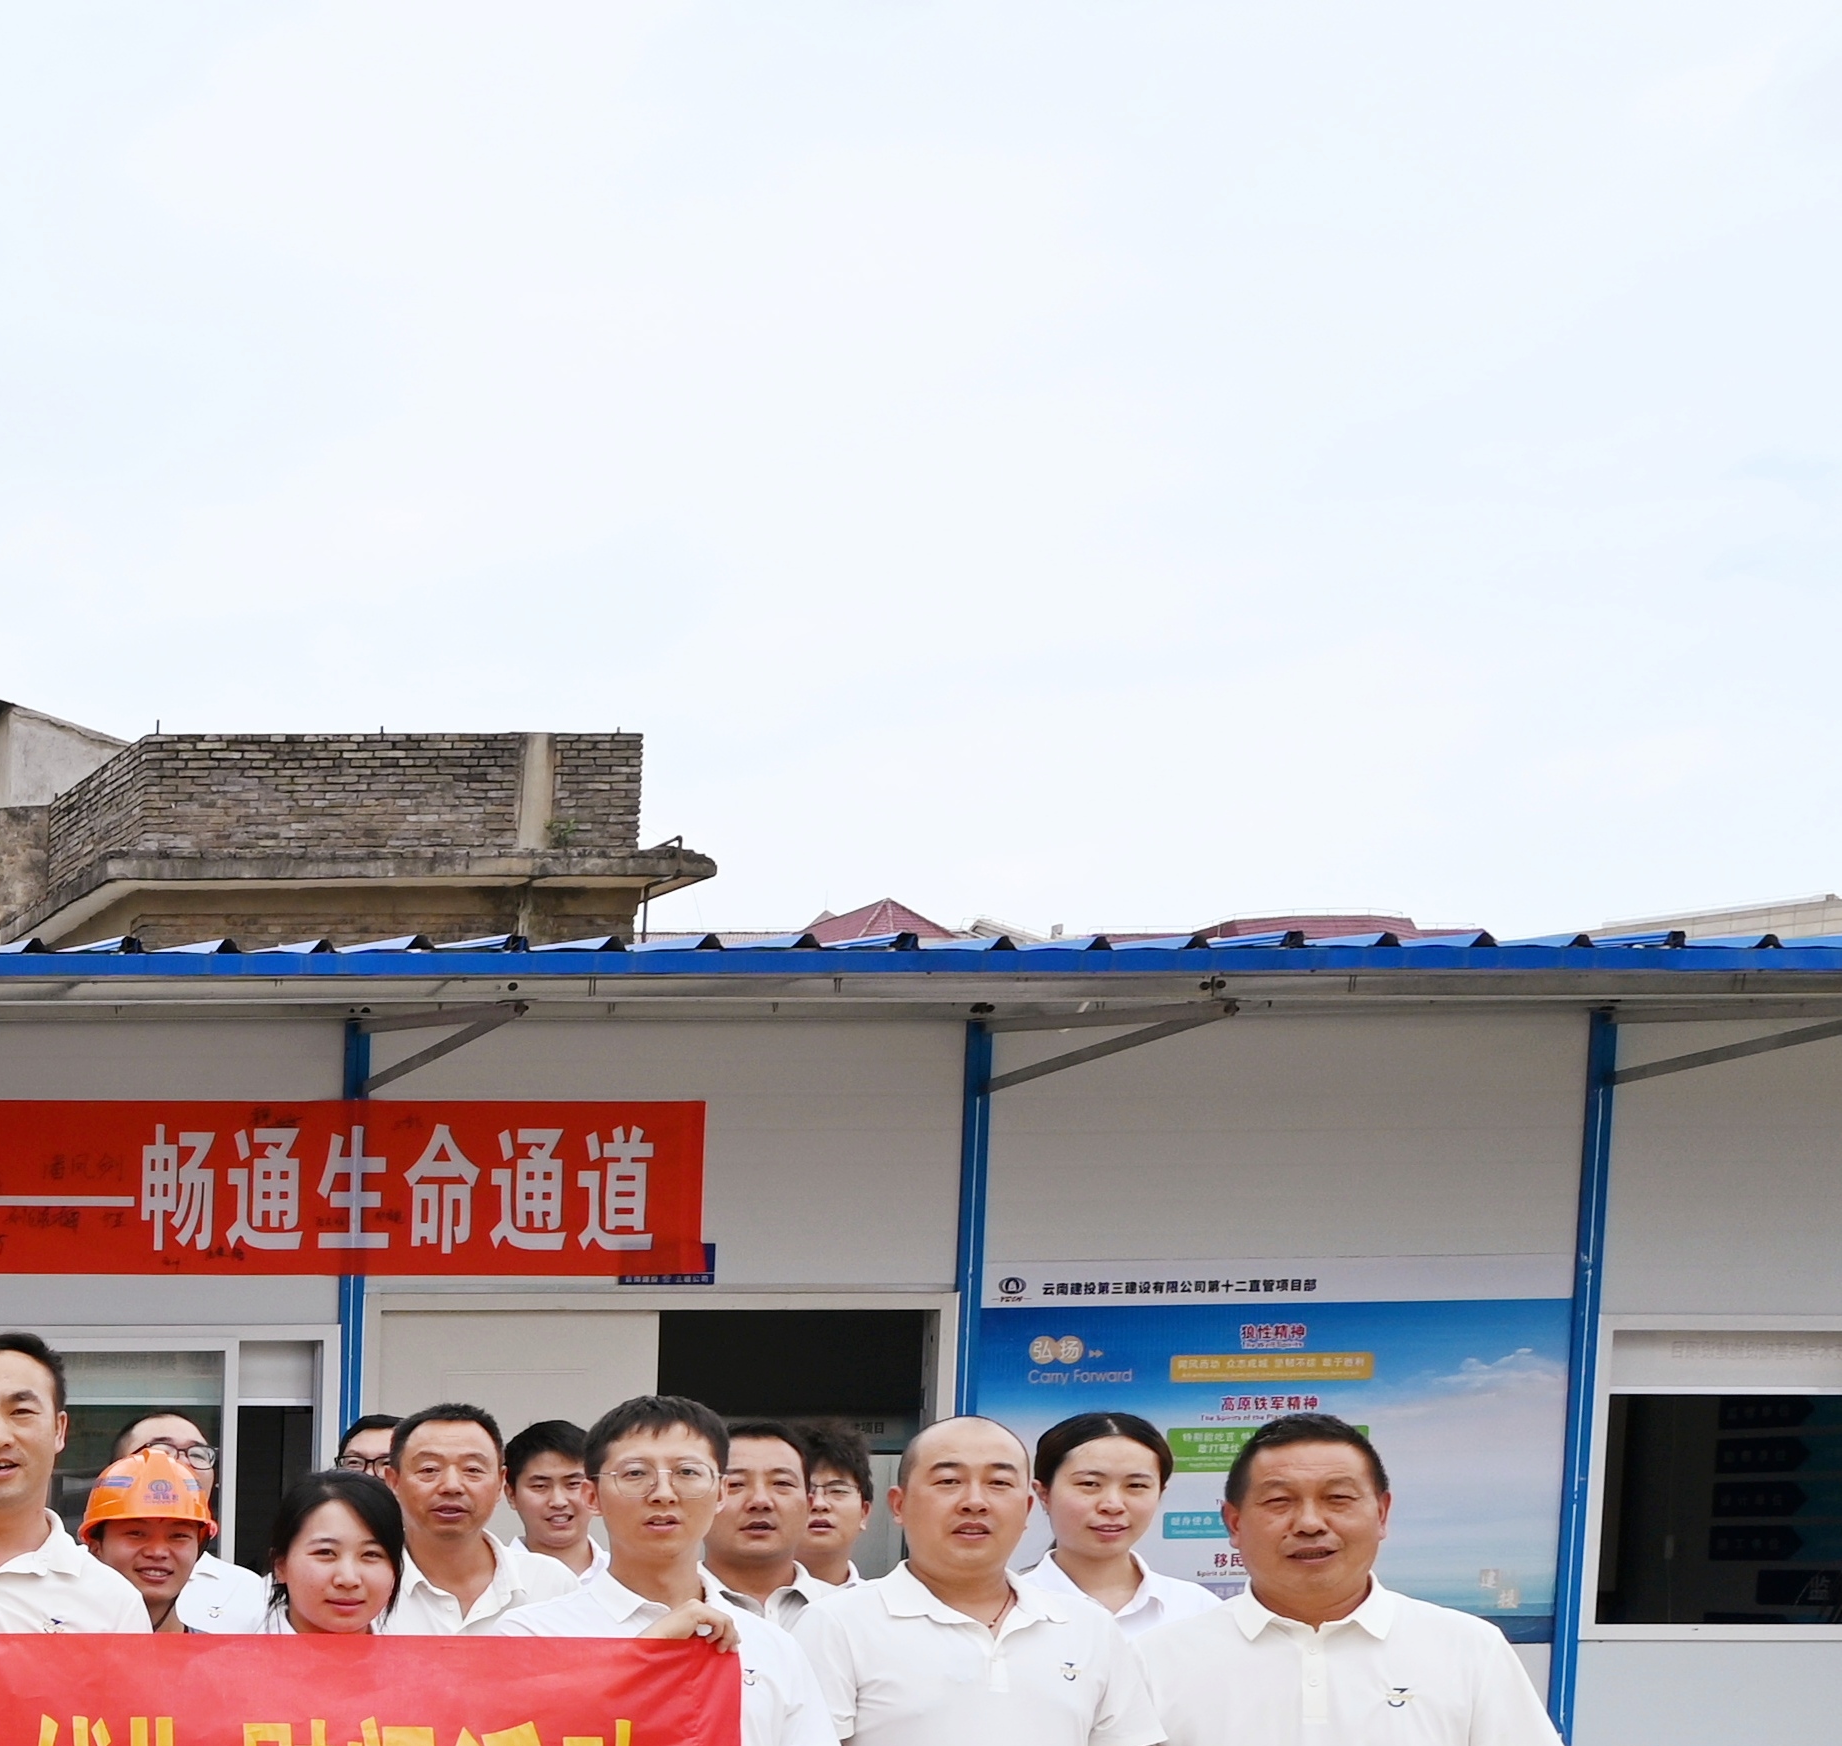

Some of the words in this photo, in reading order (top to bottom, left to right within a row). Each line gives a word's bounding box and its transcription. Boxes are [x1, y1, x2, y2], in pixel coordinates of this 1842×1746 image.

[1033, 1340, 1080, 1360] 弘扬
[1028, 1369, 1068, 1386] Carry
[1074, 1368, 1133, 1383] Forward
[1221, 1396, 1319, 1411] 高原铁军精神
